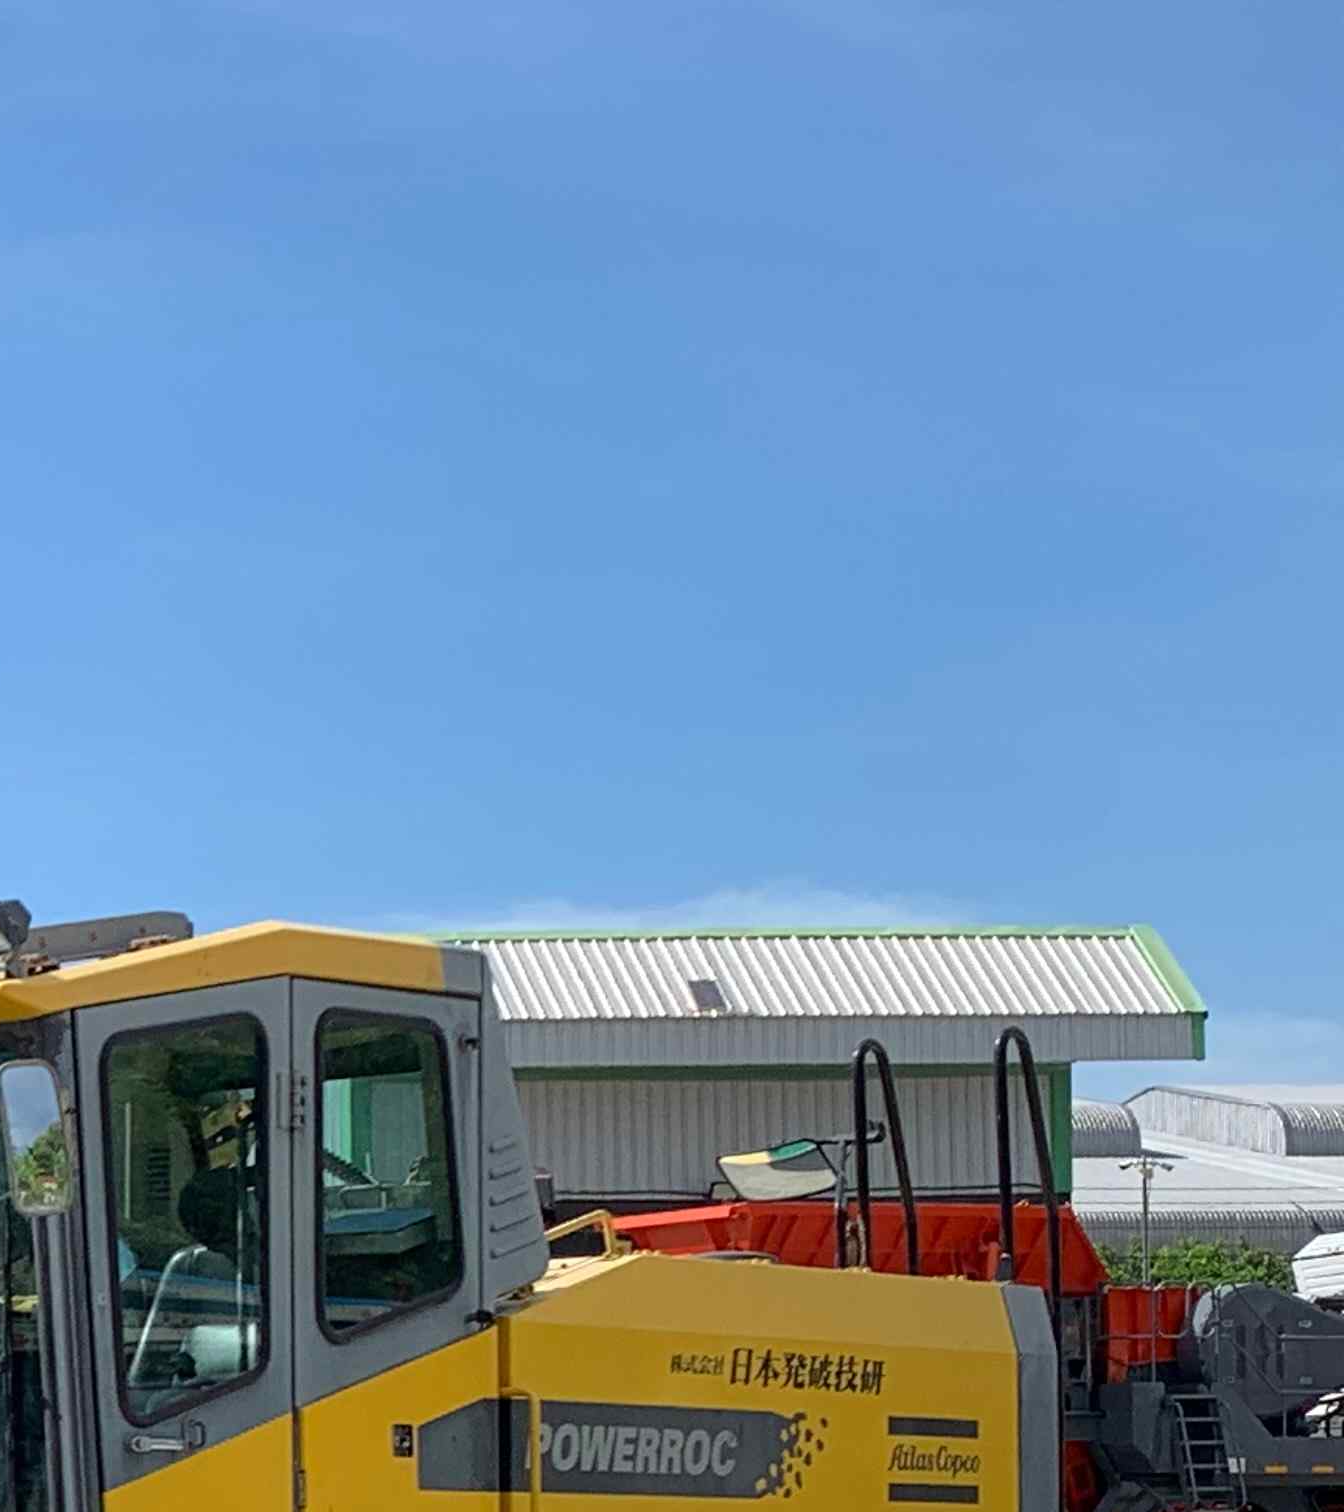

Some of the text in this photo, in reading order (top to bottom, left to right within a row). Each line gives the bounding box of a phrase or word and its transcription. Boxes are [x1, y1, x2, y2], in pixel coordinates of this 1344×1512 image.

[670, 1347, 886, 1396] 株式会社 日本発破技研
[525, 1422, 739, 1477] POWERROC
